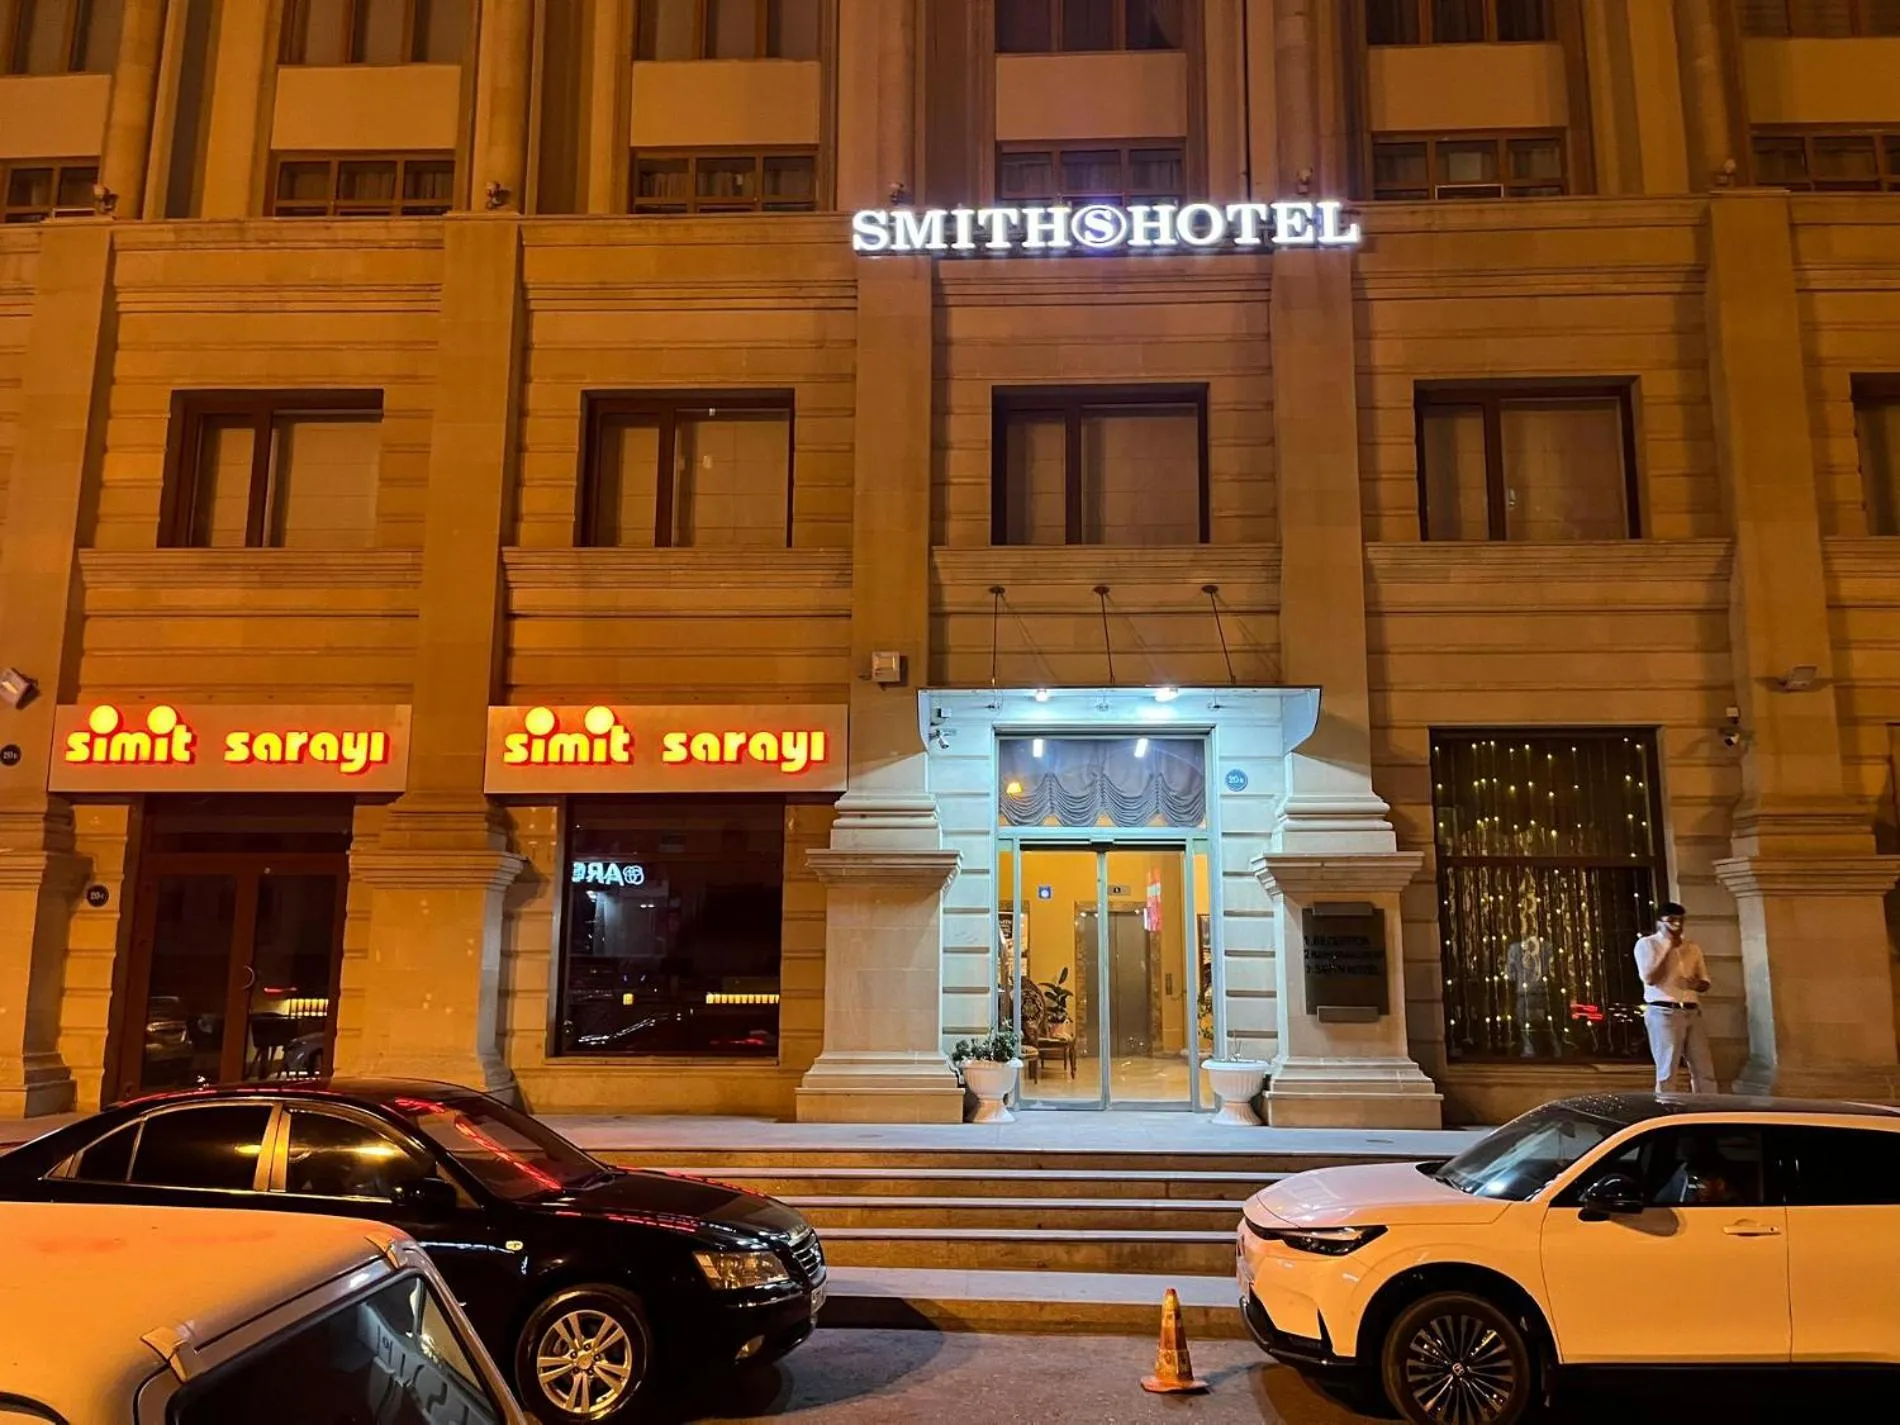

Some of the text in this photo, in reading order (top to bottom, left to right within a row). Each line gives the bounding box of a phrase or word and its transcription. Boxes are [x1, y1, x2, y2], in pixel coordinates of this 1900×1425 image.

[852, 207, 1071, 250] SMITH
[1127, 202, 1359, 247] HOTEL
[65, 705, 386, 774] simit sarayı
[503, 706, 827, 773] simit sarayı
